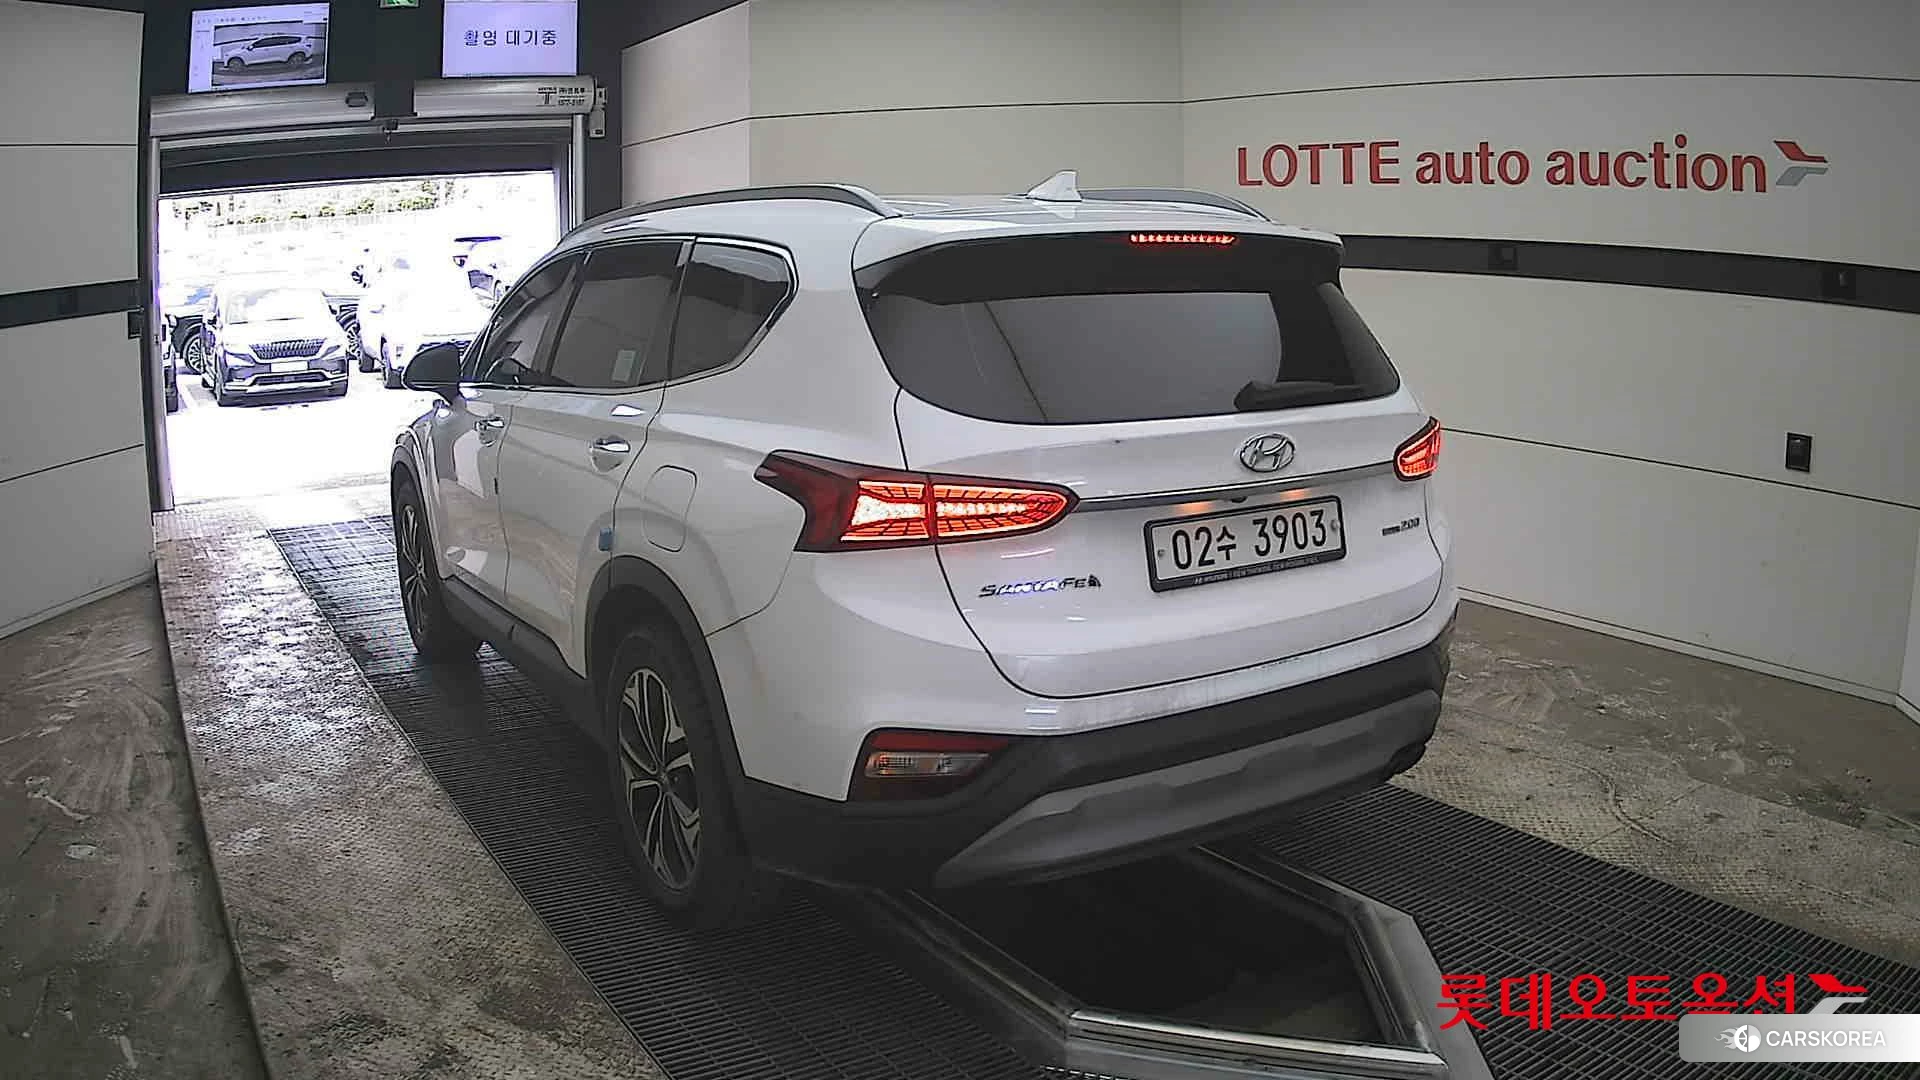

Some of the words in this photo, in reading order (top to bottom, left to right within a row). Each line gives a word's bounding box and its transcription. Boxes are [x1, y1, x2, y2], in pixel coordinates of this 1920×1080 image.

[464, 29, 497, 47] 촬영
[506, 29, 557, 46] 대기중
[1237, 141, 1400, 187] LOTTE
[1415, 141, 1530, 185] auto
[1546, 134, 1767, 193] auction
[1171, 525, 1237, 570] 02수
[1252, 509, 1327, 557] 3903
